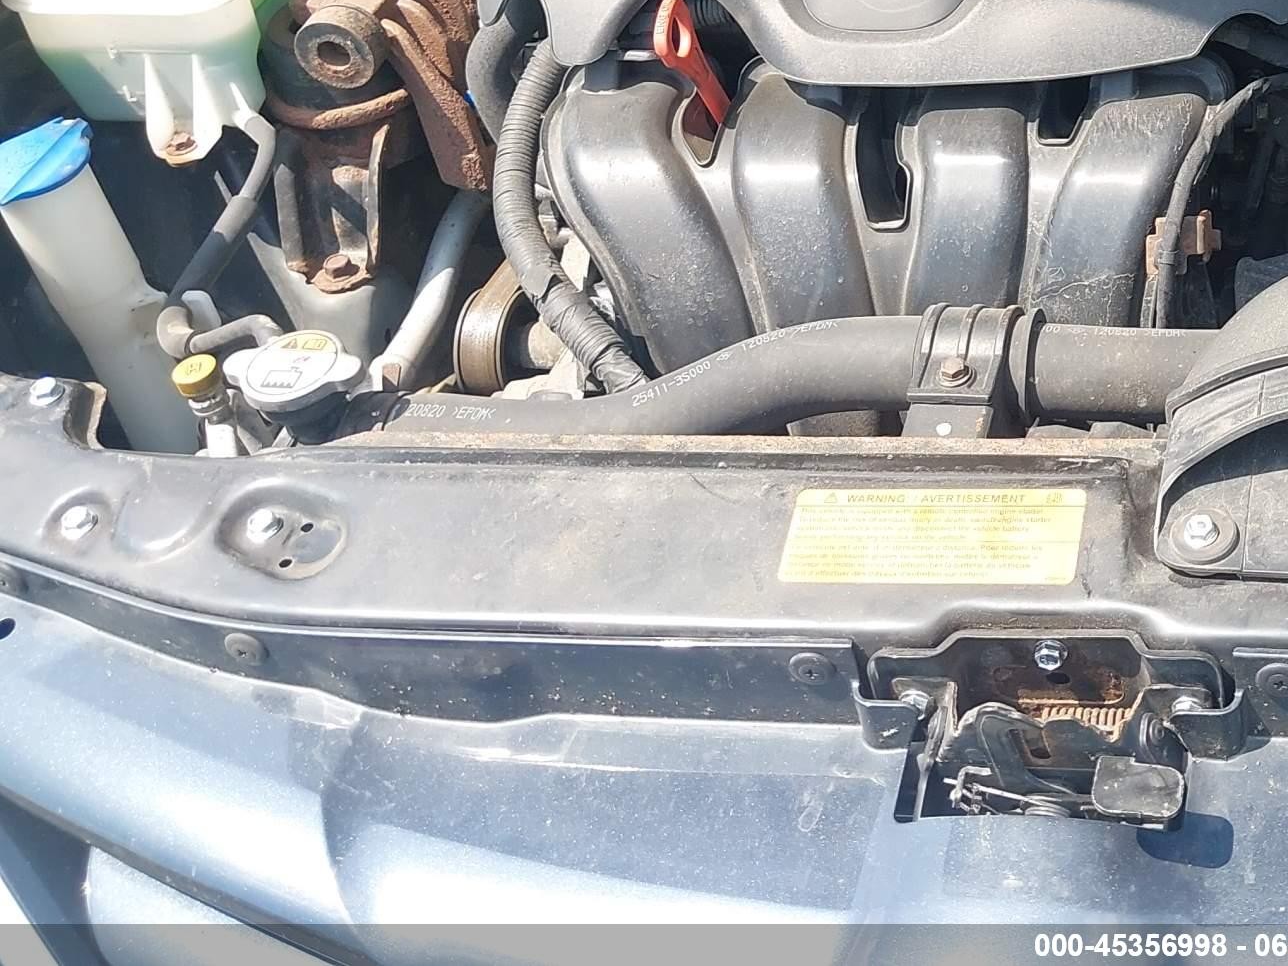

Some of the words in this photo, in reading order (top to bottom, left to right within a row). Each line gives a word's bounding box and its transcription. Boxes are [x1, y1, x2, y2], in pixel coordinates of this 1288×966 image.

[631, 360, 711, 407] 25411-3S000
[847, 494, 906, 503] WARNING
[920, 494, 1026, 504] AVERTISSEMENT
